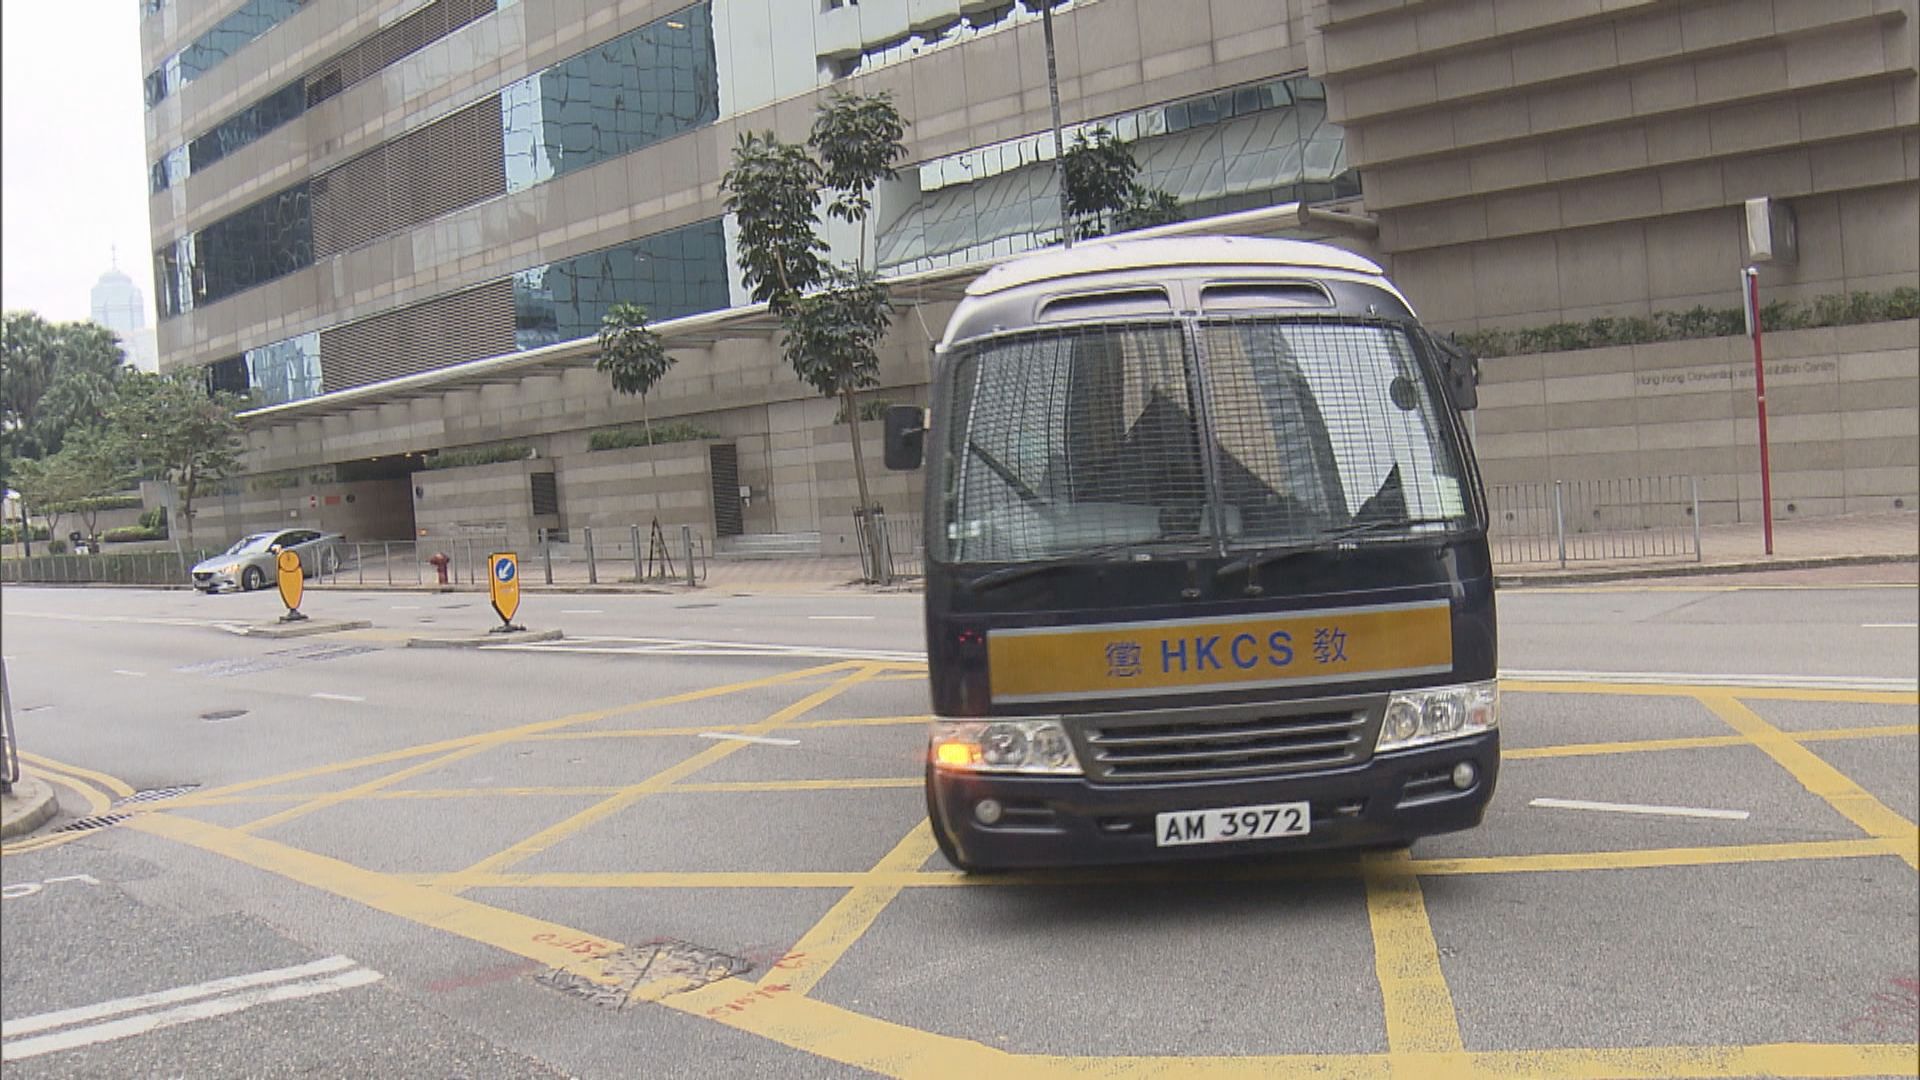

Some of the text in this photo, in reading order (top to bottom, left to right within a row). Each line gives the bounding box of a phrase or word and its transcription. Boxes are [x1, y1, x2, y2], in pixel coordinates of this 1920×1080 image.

[1161, 631, 1294, 674] HKCS
[1164, 808, 1303, 842] AM 3972
